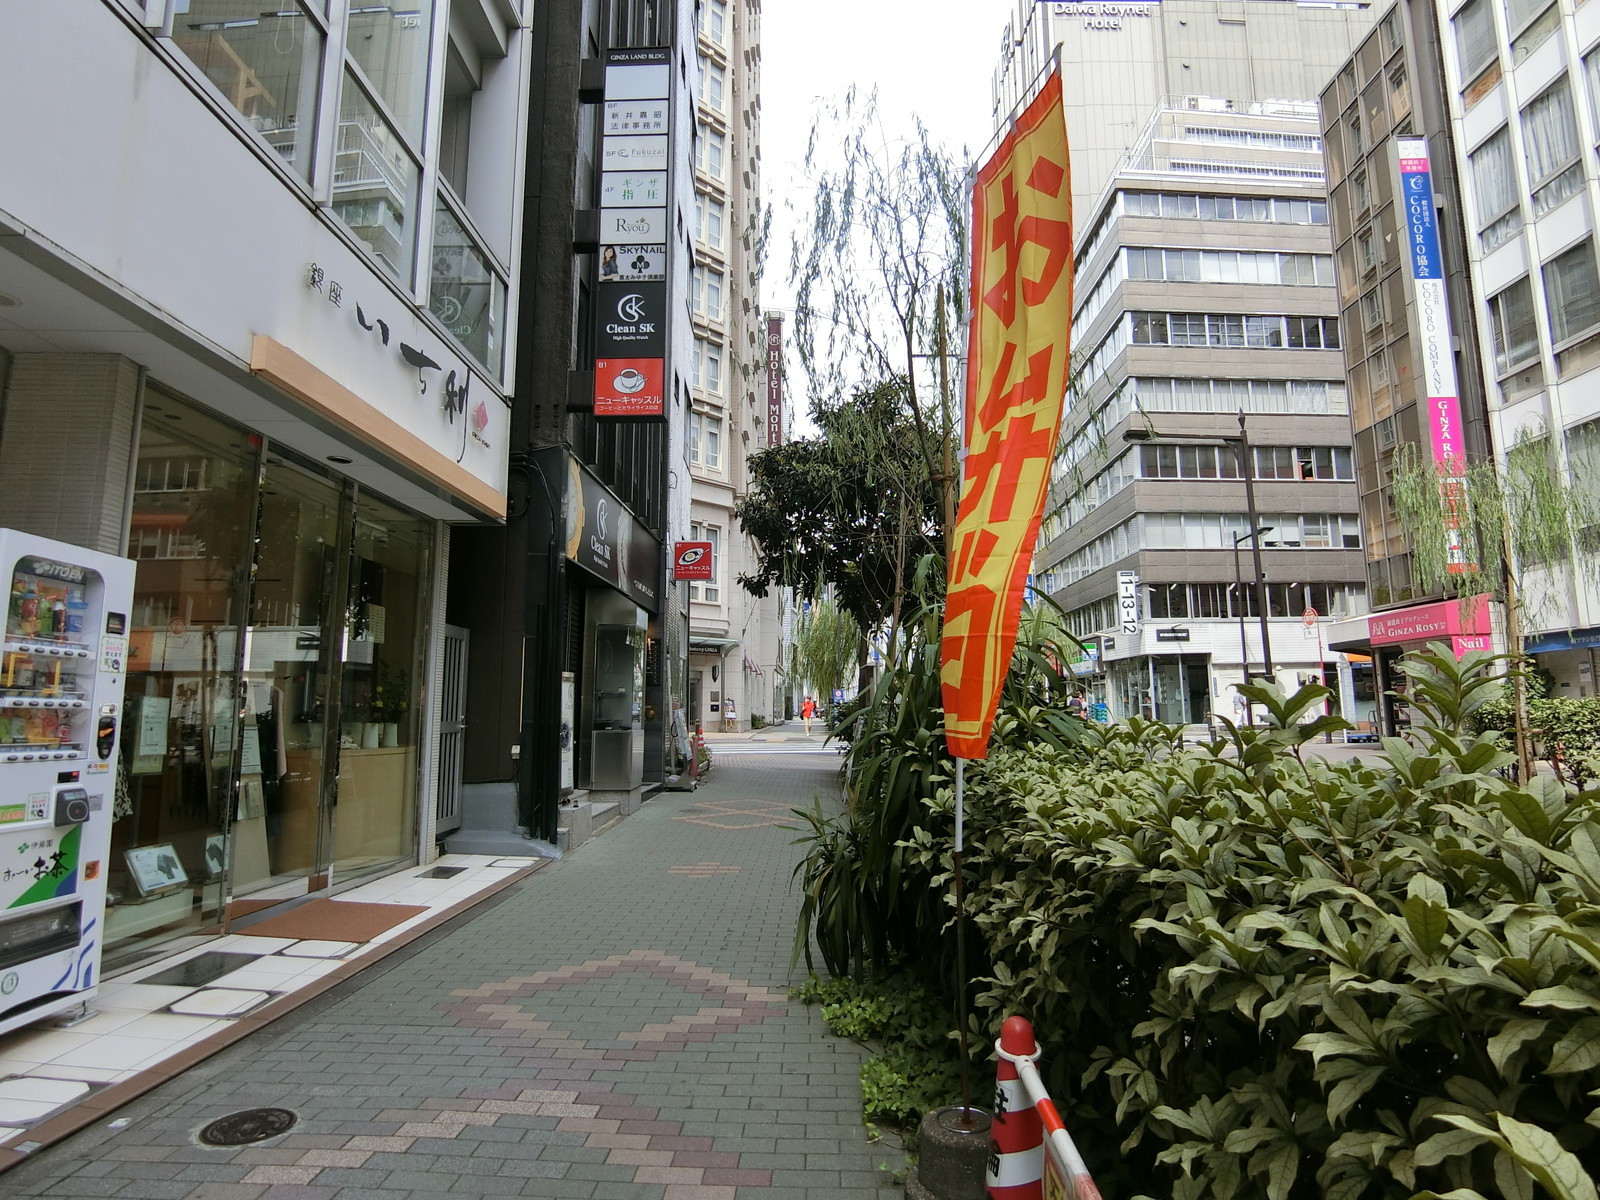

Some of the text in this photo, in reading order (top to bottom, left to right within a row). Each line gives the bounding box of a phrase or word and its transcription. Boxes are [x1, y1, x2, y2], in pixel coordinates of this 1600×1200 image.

[1054, 2, 1151, 17] Daiwa Roynet
[1083, 18, 1122, 29] Hotel
[610, 122, 662, 130] 法律事務所
[622, 178, 658, 188] ギンザ
[622, 189, 658, 200] 指圧
[620, 246, 666, 254] SKYNAIL
[308, 263, 343, 309] 銀座
[606, 322, 656, 334] Clean SK
[1422, 282, 1441, 394] COCORO COMPANY
[770, 350, 780, 400] Hotel
[596, 396, 662, 405] ニューキャッスル
[1438, 401, 1451, 440] GINZA
[50, 564, 84, 581] ITO EN
[1388, 627, 1414, 637] GINZA
[1416, 622, 1440, 632] ROSY
[1458, 638, 1485, 649] Nail
[31, 839, 53, 848] 伊藤園
